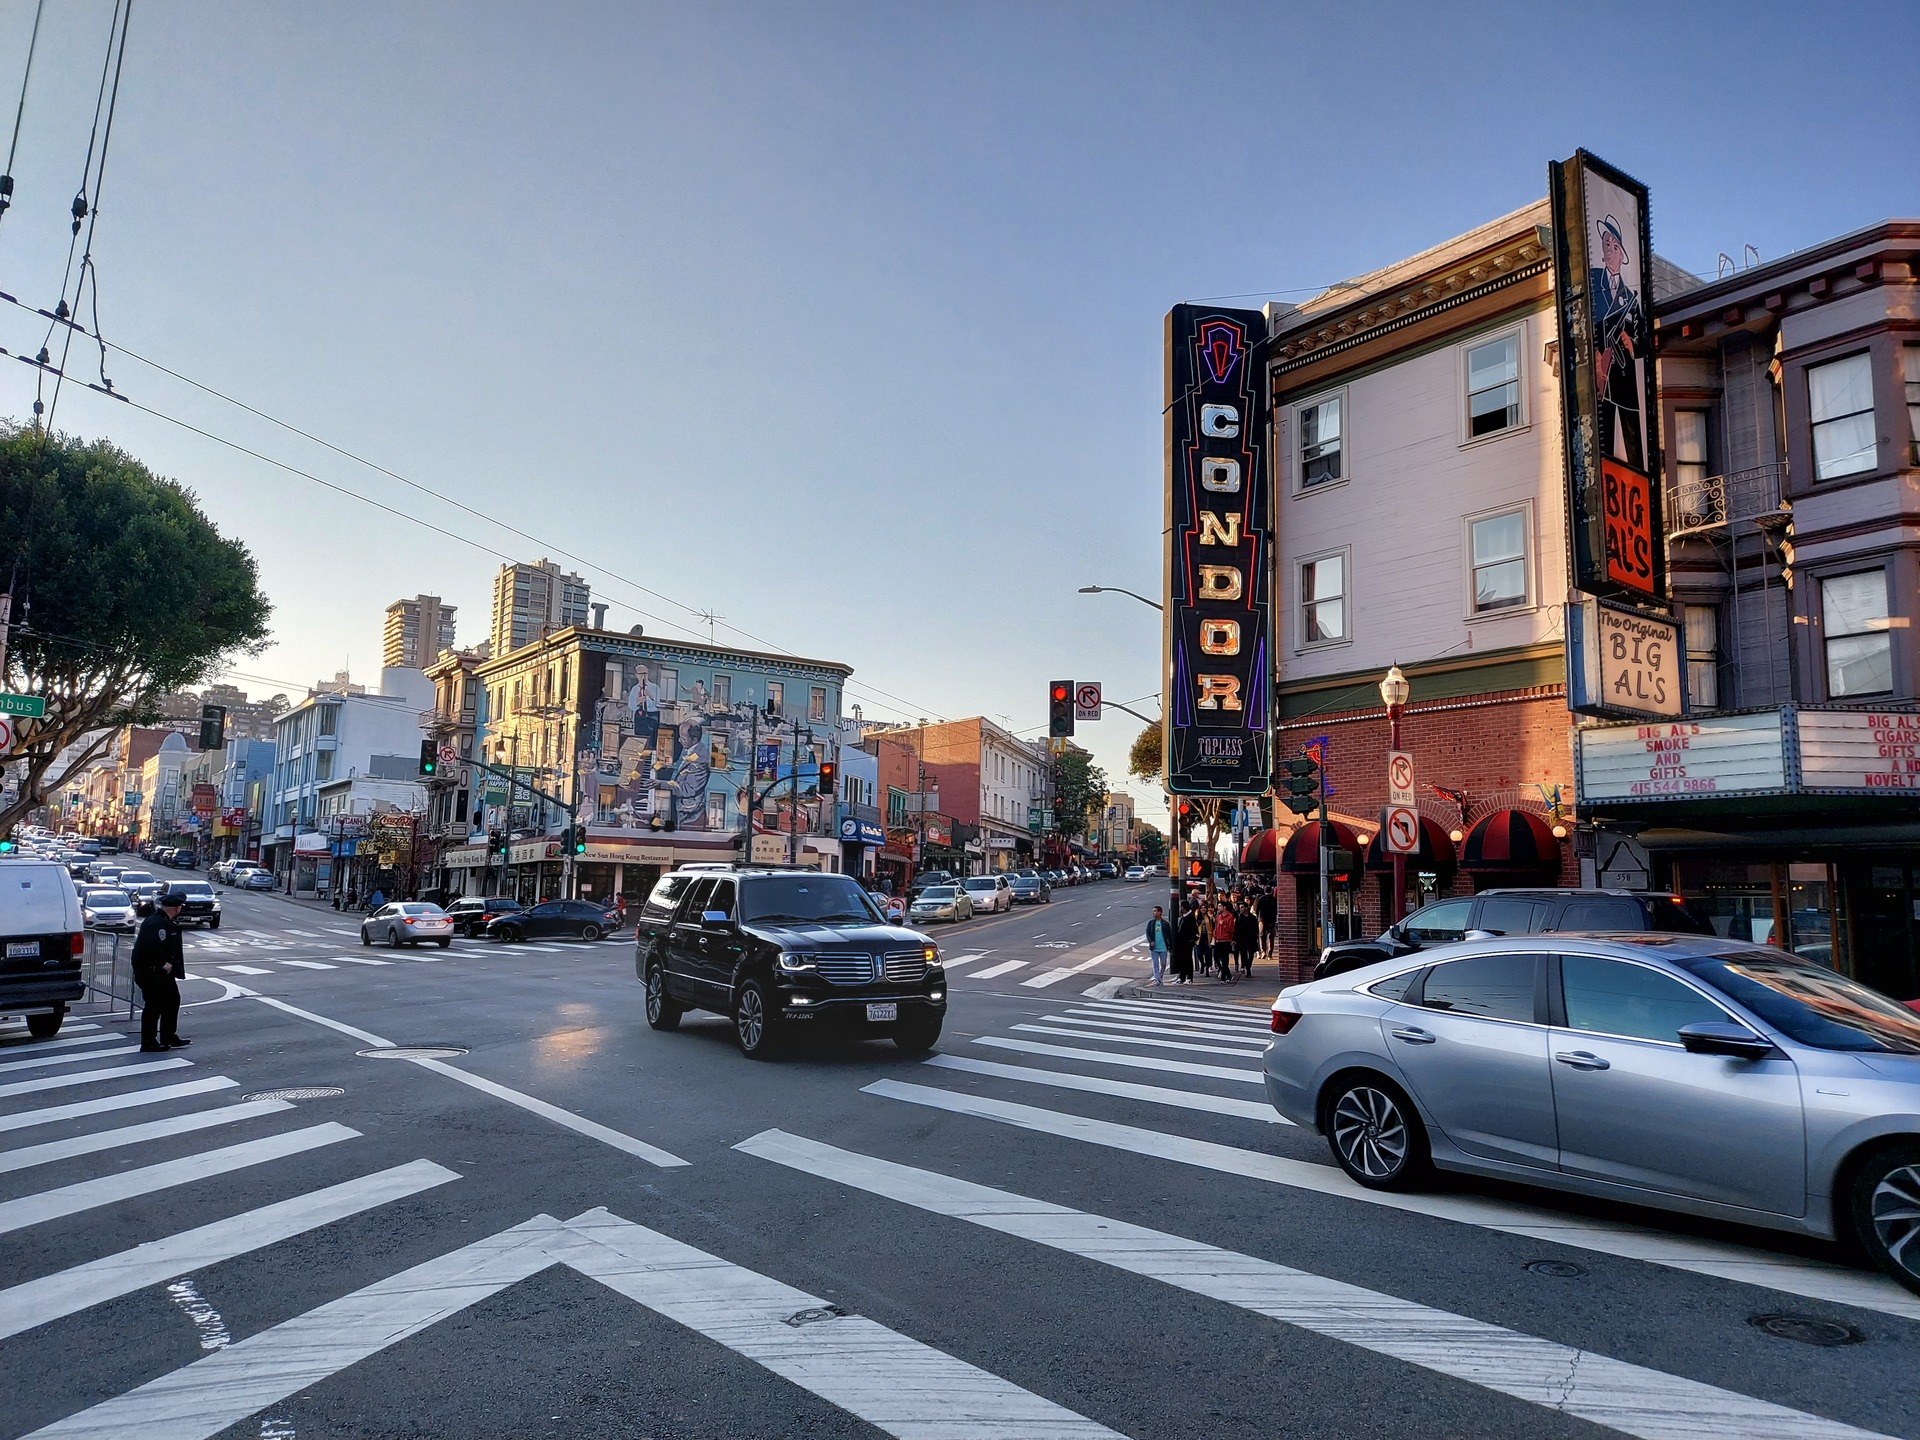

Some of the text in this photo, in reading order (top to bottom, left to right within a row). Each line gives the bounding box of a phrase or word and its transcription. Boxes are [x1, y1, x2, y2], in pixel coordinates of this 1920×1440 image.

[1605, 473, 1644, 529] BIG
[1198, 403, 1243, 711] CONDOR
[1606, 522, 1650, 579] AL'S
[1601, 611, 1672, 641] The Original
[1610, 632, 1661, 671] BIG
[1614, 669, 1666, 704] AL'S
[0, 698, 33, 712] bus
[1868, 715, 1890, 728] BIG
[1638, 726, 1661, 739] BIG
[1874, 730, 1919, 743] CIGARS
[1197, 737, 1243, 756] TOPLESS
[1646, 738, 1690, 752] SMOKE
[1878, 745, 1915, 757] GIFTS
[1655, 752, 1681, 766] AND
[1650, 766, 1687, 779] GIFTS
[1630, 778, 1717, 795] 415 544 9866
[1392, 792, 1412, 801] ON RED
[583, 851, 596, 859] New
[609, 852, 625, 860] Hong
[625, 853, 640, 861] Kong
[1616, 873, 1631, 881] 558
